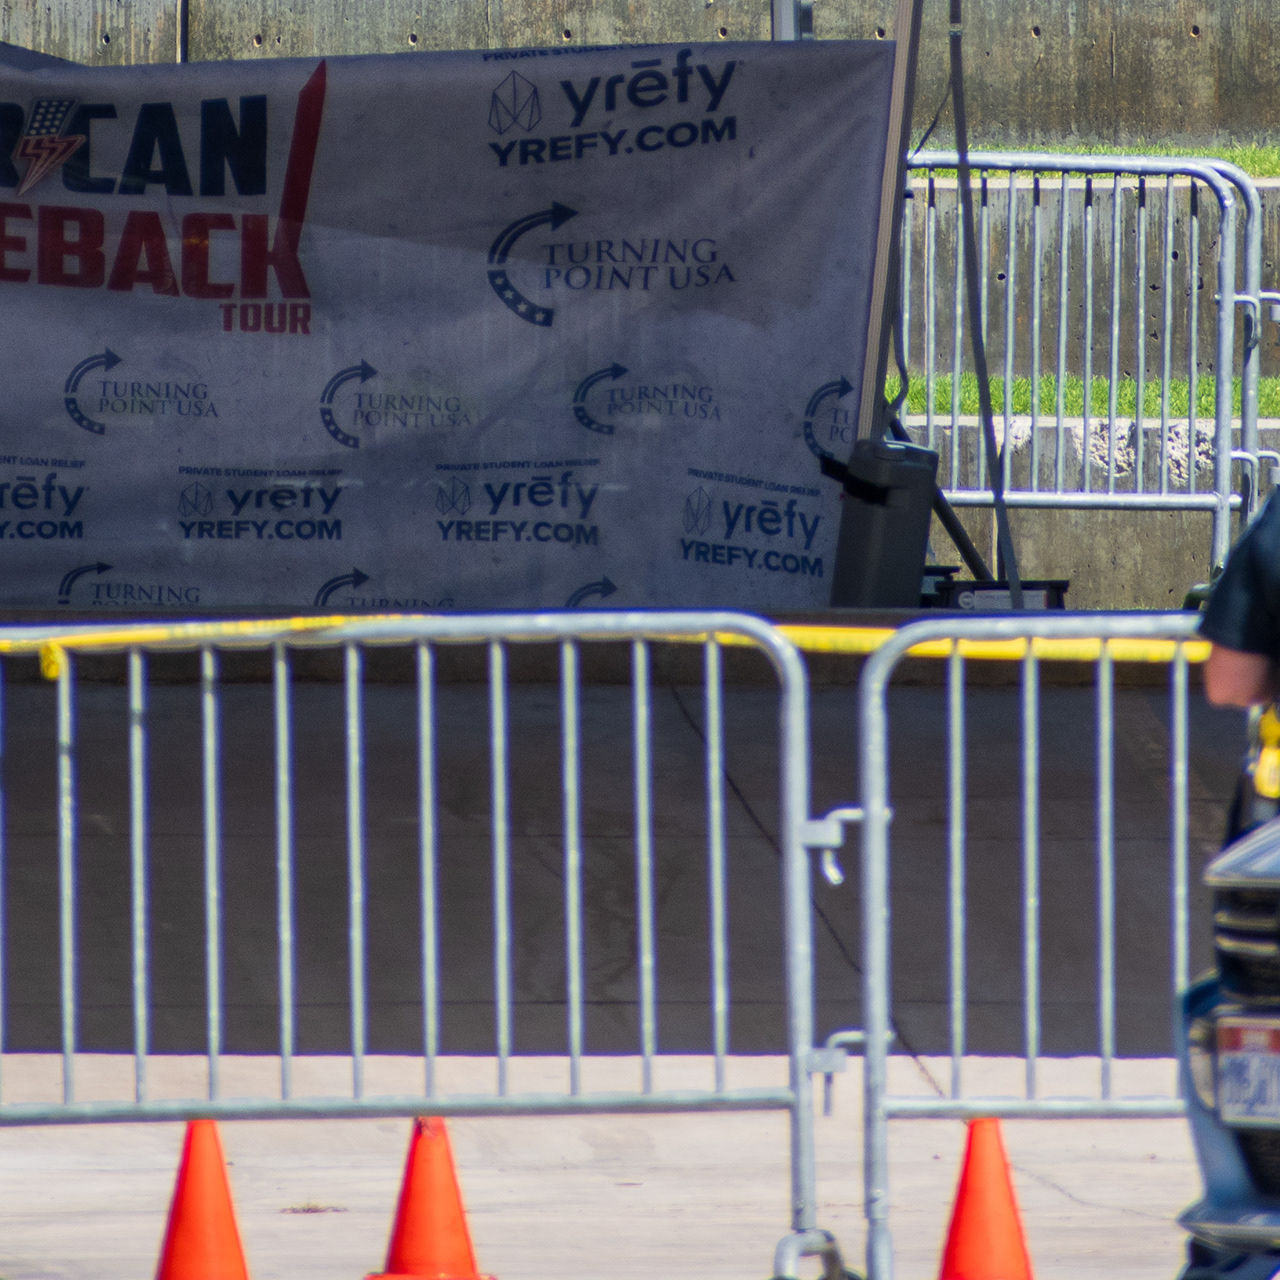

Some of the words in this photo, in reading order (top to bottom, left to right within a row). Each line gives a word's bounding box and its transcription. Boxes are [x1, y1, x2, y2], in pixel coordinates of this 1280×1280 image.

[488, 116, 737, 167] YREFY.COM
[542, 238, 718, 266] TURNING
[543, 265, 657, 291] POINT
[668, 261, 737, 287] USA
[222, 303, 312, 335] TOUR
[98, 379, 208, 400] TURNING
[607, 384, 715, 405] TURNING
[98, 397, 172, 416] POINT
[176, 400, 219, 419] USA
[353, 393, 461, 414] TURNING
[606, 397, 676, 419] POINT
[684, 400, 721, 422] USA
[352, 411, 424, 429] POINT
[431, 410, 472, 429] USA
[19, 456, 48, 467] LOAN
[50, 458, 86, 469] RELIEF
[178, 466, 222, 477] PRIVATE
[224, 468, 275, 478] STUDENT
[276, 469, 306, 478] LOAN
[435, 462, 480, 472] PRIVATE
[481, 460, 532, 470] STUDENT
[533, 460, 563, 469] LOAN
[178, 519, 342, 540] YREFY.COM
[436, 519, 599, 546] YREFY.COM
[680, 538, 824, 579] YREFY.COM
[91, 583, 200, 604] TURNING
